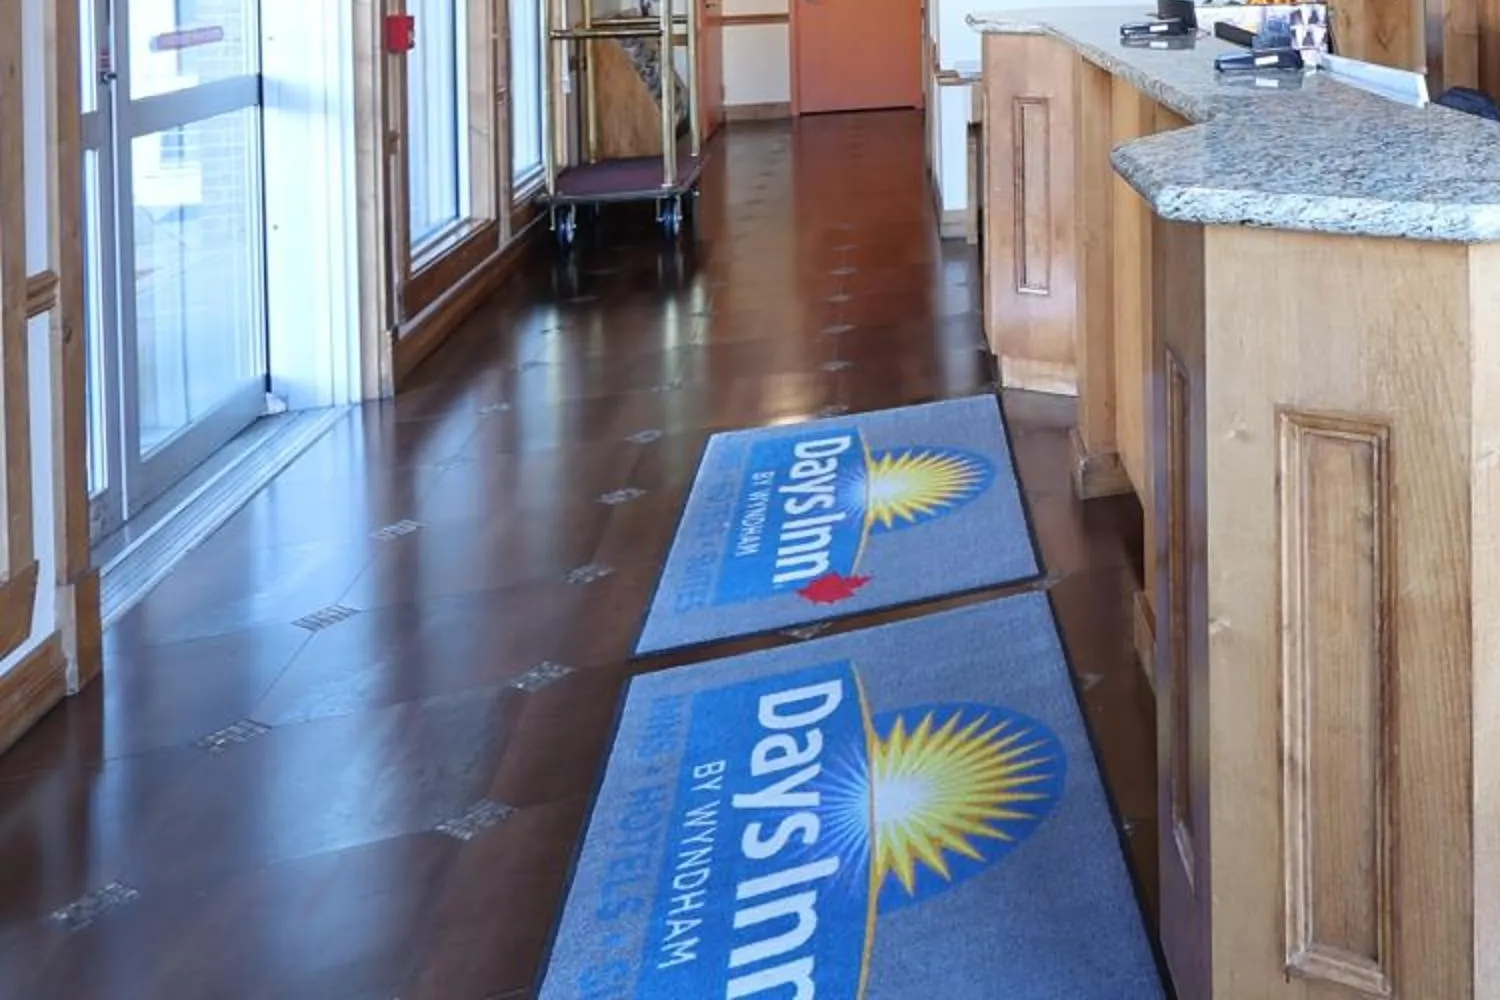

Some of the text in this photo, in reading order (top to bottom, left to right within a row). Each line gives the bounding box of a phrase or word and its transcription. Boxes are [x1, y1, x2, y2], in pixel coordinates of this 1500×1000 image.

[736, 470, 775, 557] BY WYNDHAM
[656, 759, 727, 969] BY WYNDHAM
